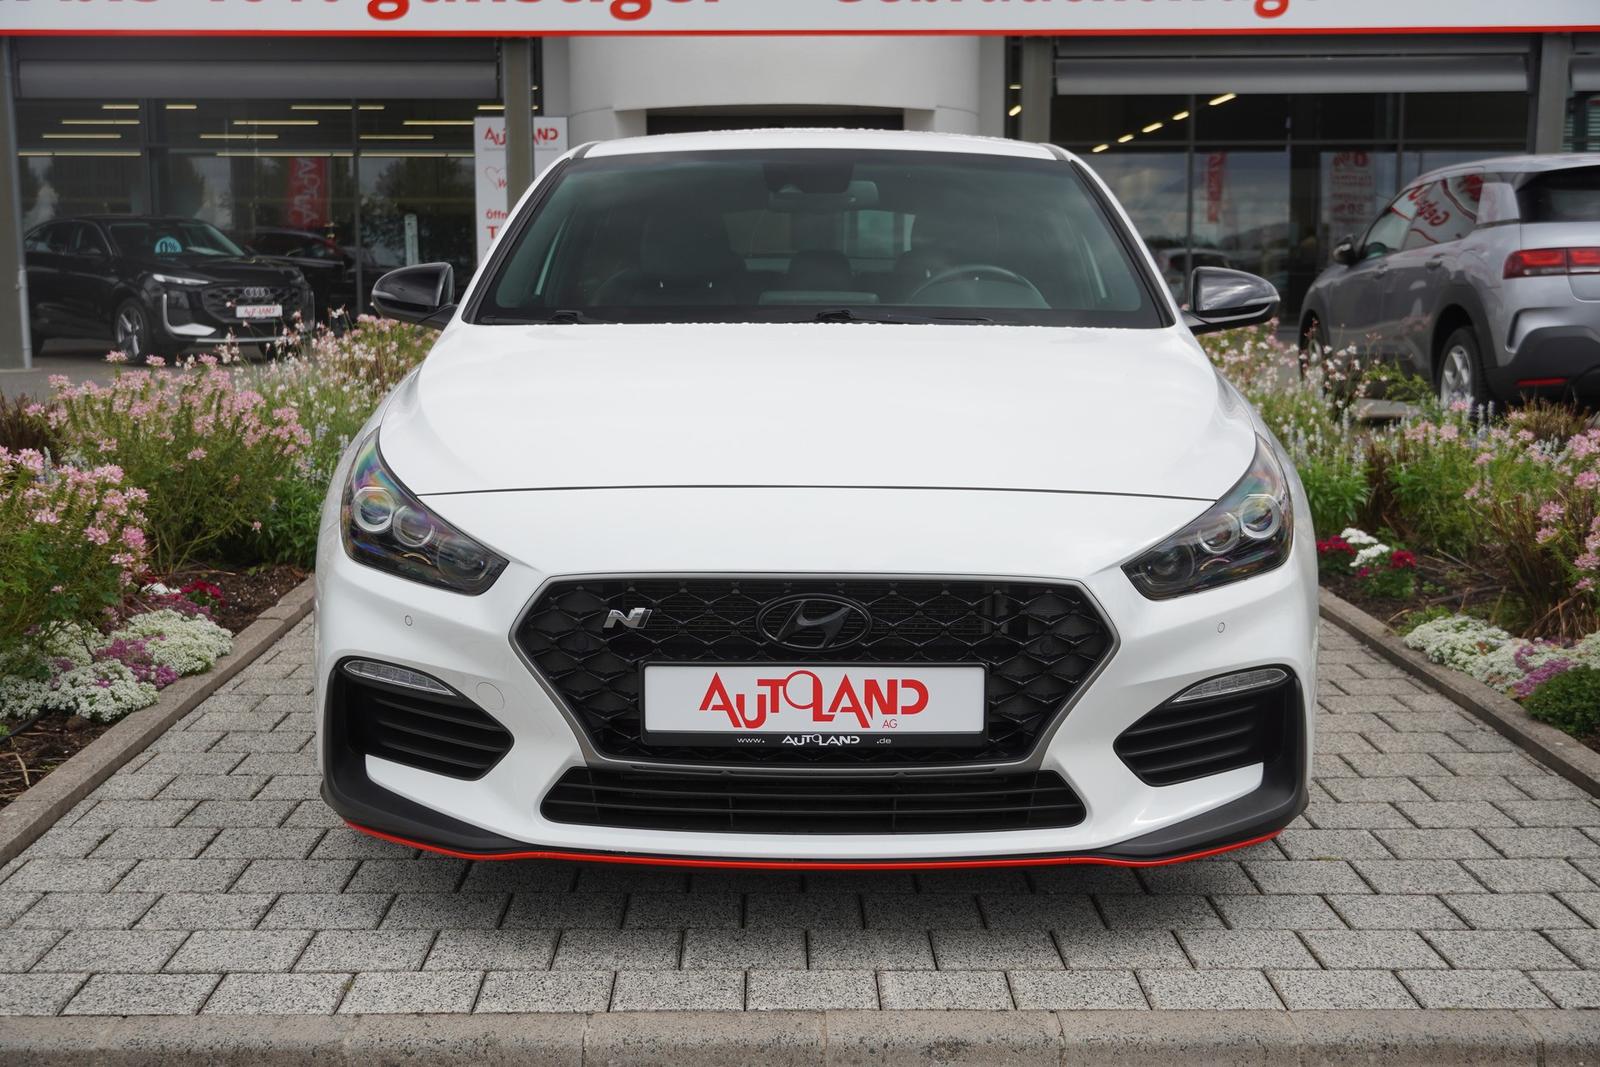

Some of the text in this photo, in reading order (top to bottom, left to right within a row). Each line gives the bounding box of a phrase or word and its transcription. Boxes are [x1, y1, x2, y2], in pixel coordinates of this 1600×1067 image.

[699, 670, 929, 729] AUTOLAND
[882, 719, 898, 729] AG
[781, 733, 861, 747] AUTOLAND
[876, 736, 892, 745] .de
